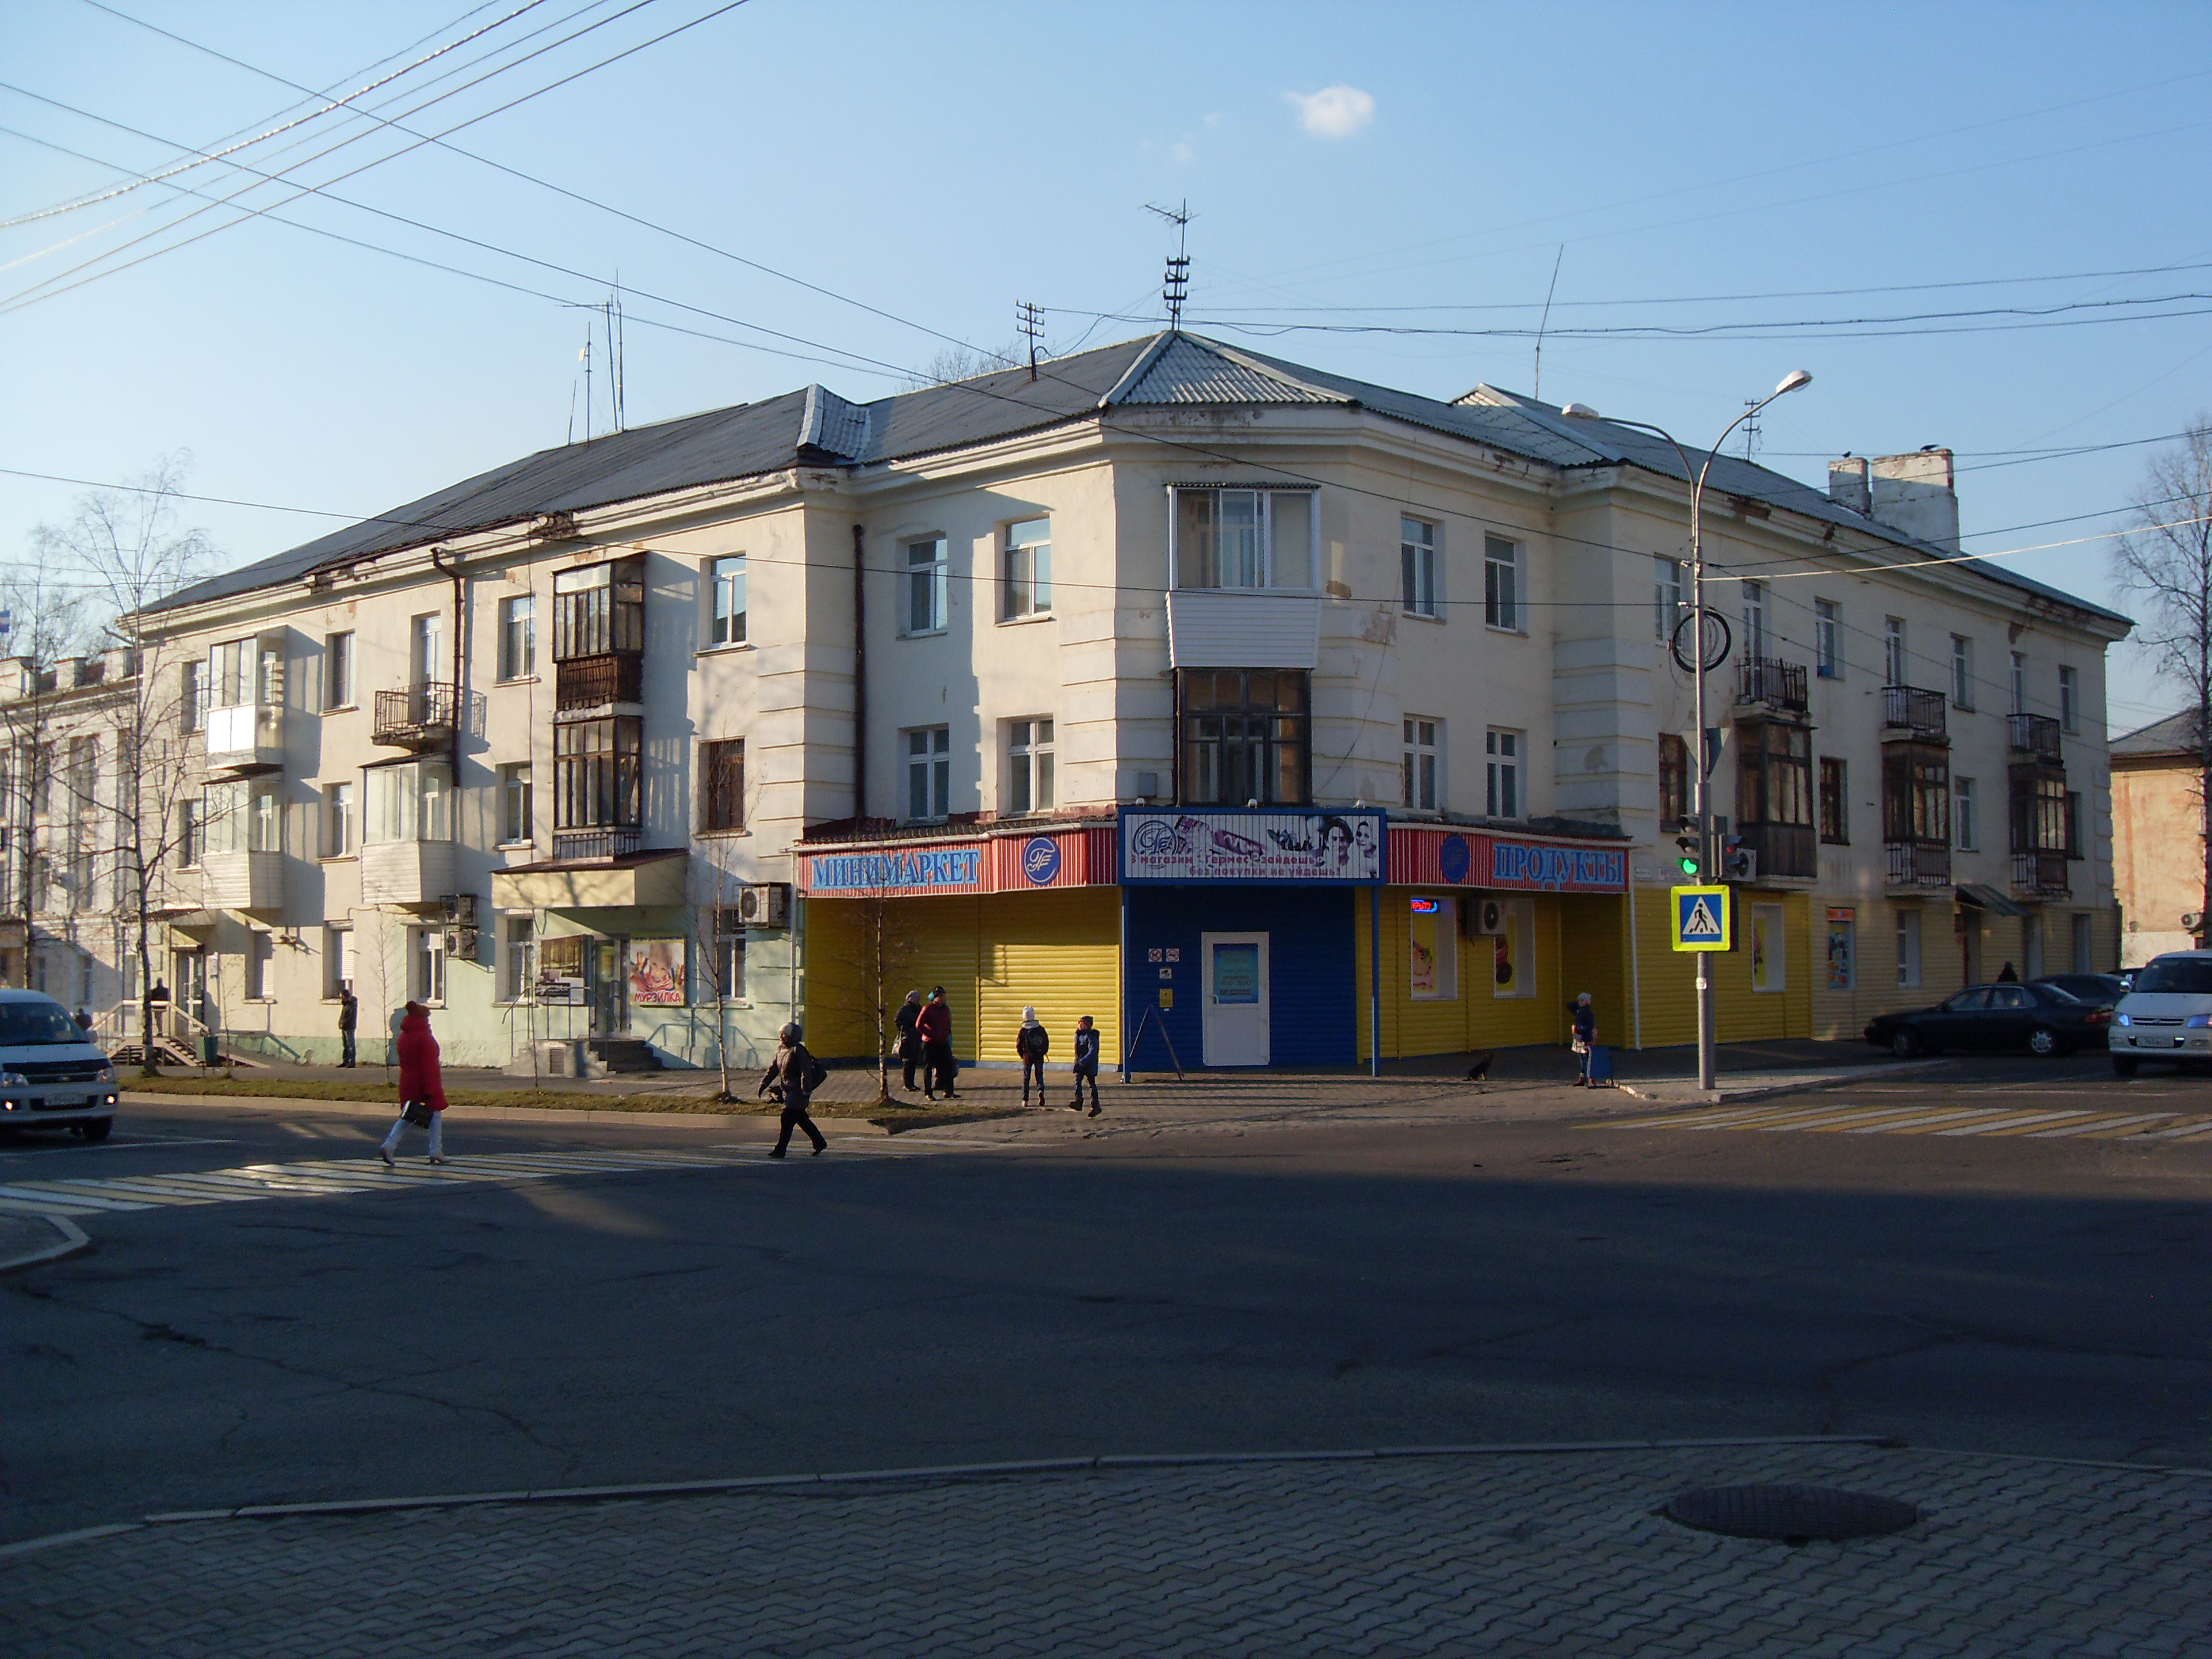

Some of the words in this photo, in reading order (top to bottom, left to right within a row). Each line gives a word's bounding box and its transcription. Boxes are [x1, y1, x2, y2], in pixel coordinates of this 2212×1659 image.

[1140, 856, 1193, 864] магазин
[1495, 846, 1624, 886] ПРОДУКТЫ
[812, 850, 979, 887] МИНИМАРКЕТ
[1189, 865, 1210, 876] без
[1214, 868, 1265, 877] покупки
[1270, 868, 1286, 876] не
[634, 991, 681, 1003] МУРЗИЛКА
